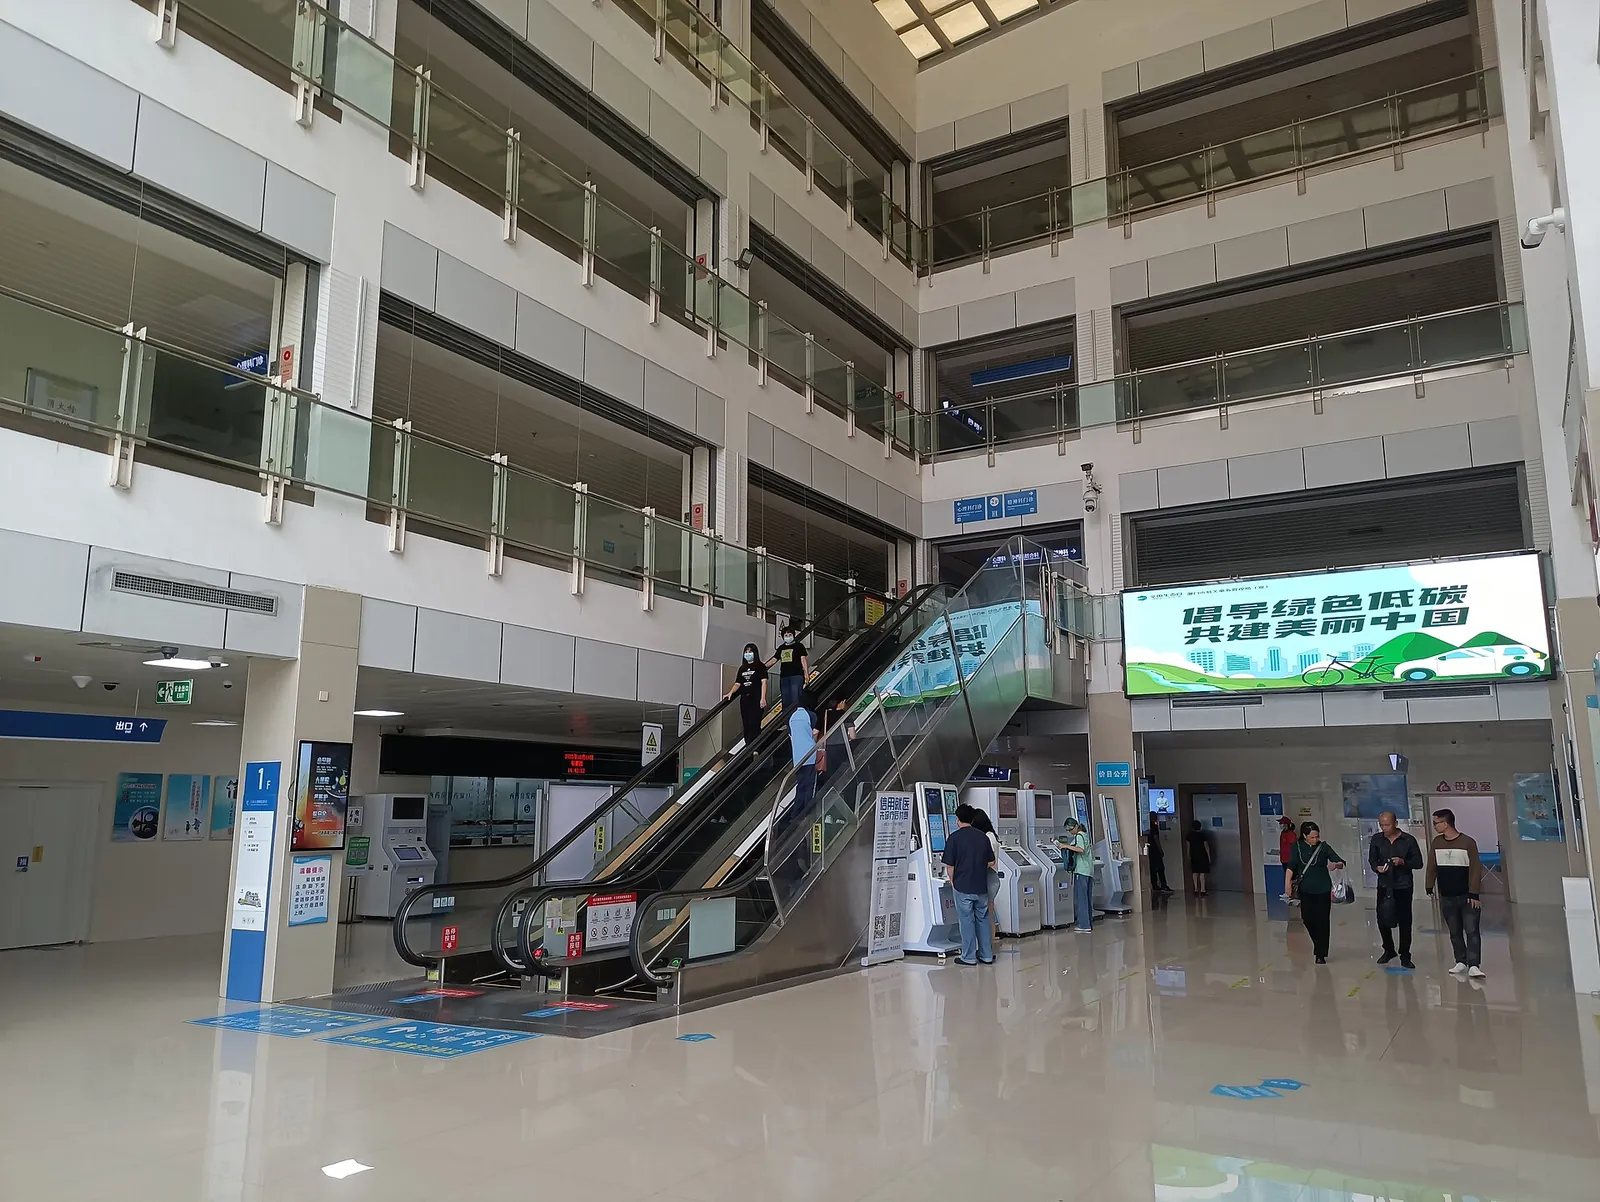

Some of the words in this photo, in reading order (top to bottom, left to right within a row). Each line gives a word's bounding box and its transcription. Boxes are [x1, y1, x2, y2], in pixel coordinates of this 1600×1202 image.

[1182, 584, 1469, 625] 倡导绿色低碳
[1184, 606, 1470, 645] 共建美丽中国
[115, 720, 134, 731] 出口
[258, 767, 272, 790] 1F
[1098, 770, 1128, 779] 价目公开
[1454, 781, 1492, 792] 母婴室
[880, 796, 910, 811] 信用就医
[879, 810, 909, 821] 先诊疗后付费
[300, 866, 324, 875] 温馨提示
